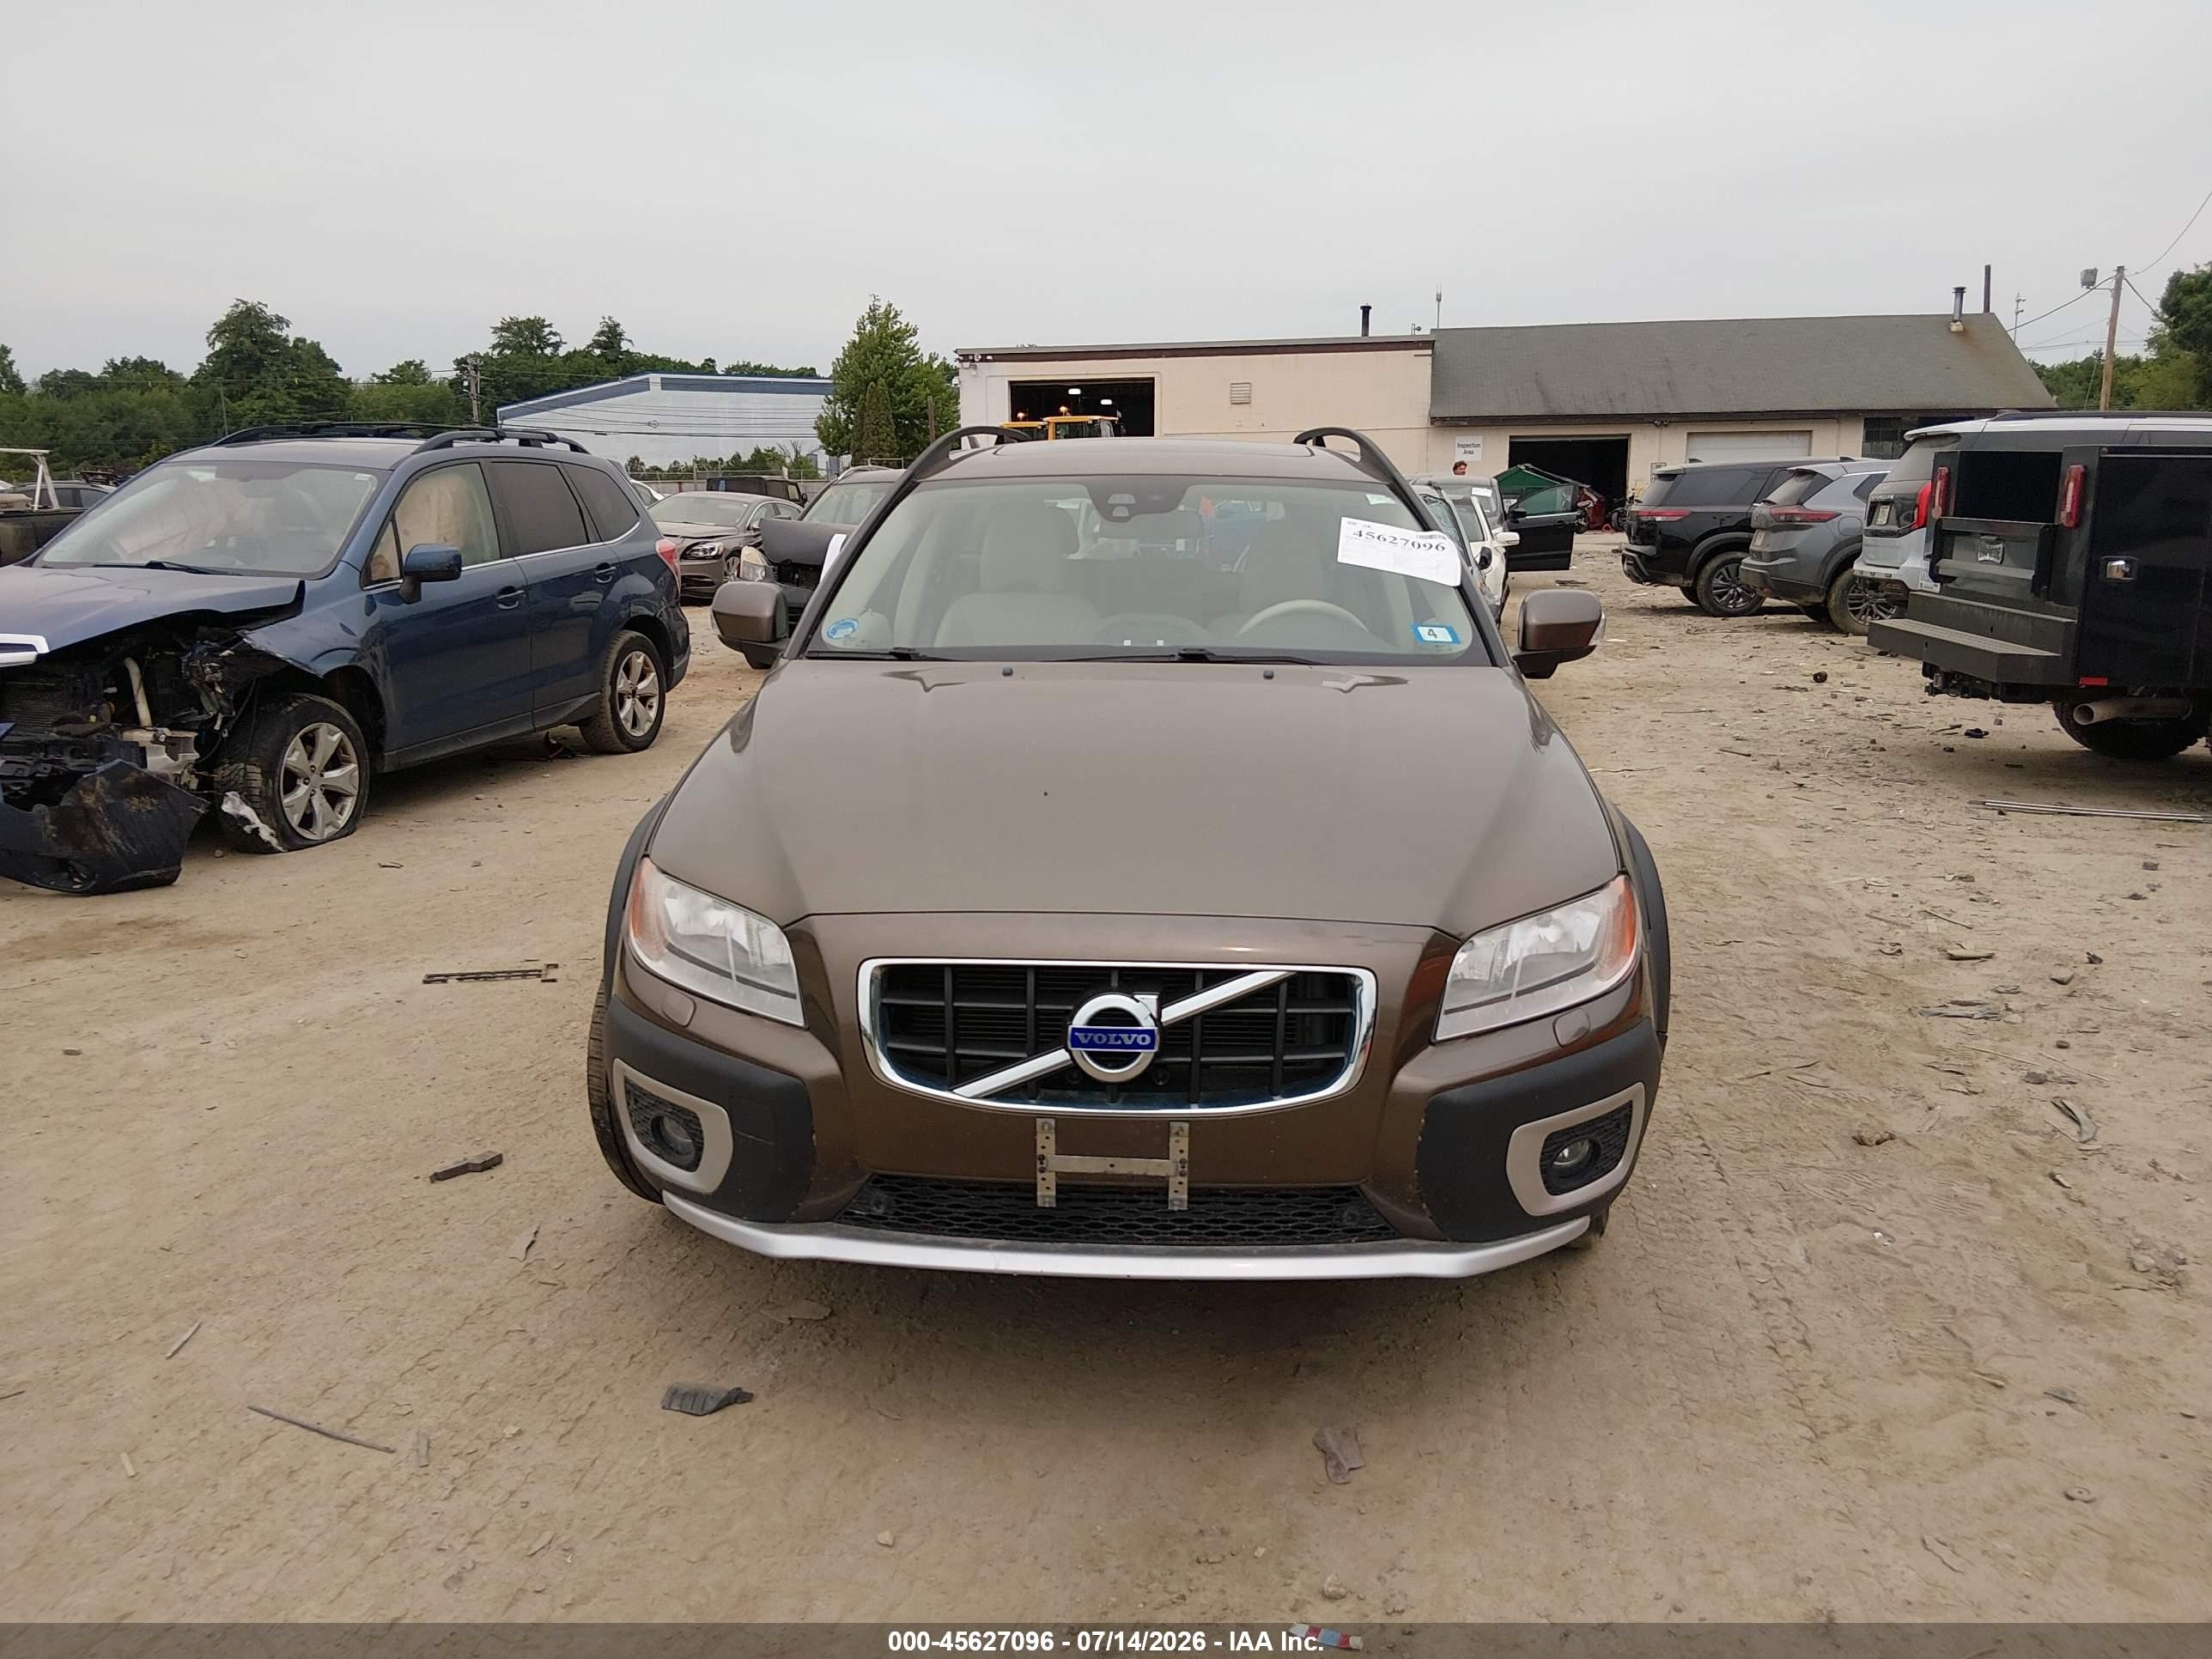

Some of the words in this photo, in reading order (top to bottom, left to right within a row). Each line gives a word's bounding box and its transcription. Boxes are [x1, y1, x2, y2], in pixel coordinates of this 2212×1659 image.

[1352, 529, 1446, 552] 45627096
[1427, 628, 1438, 639] 4
[1074, 1031, 1152, 1046] VOLVO
